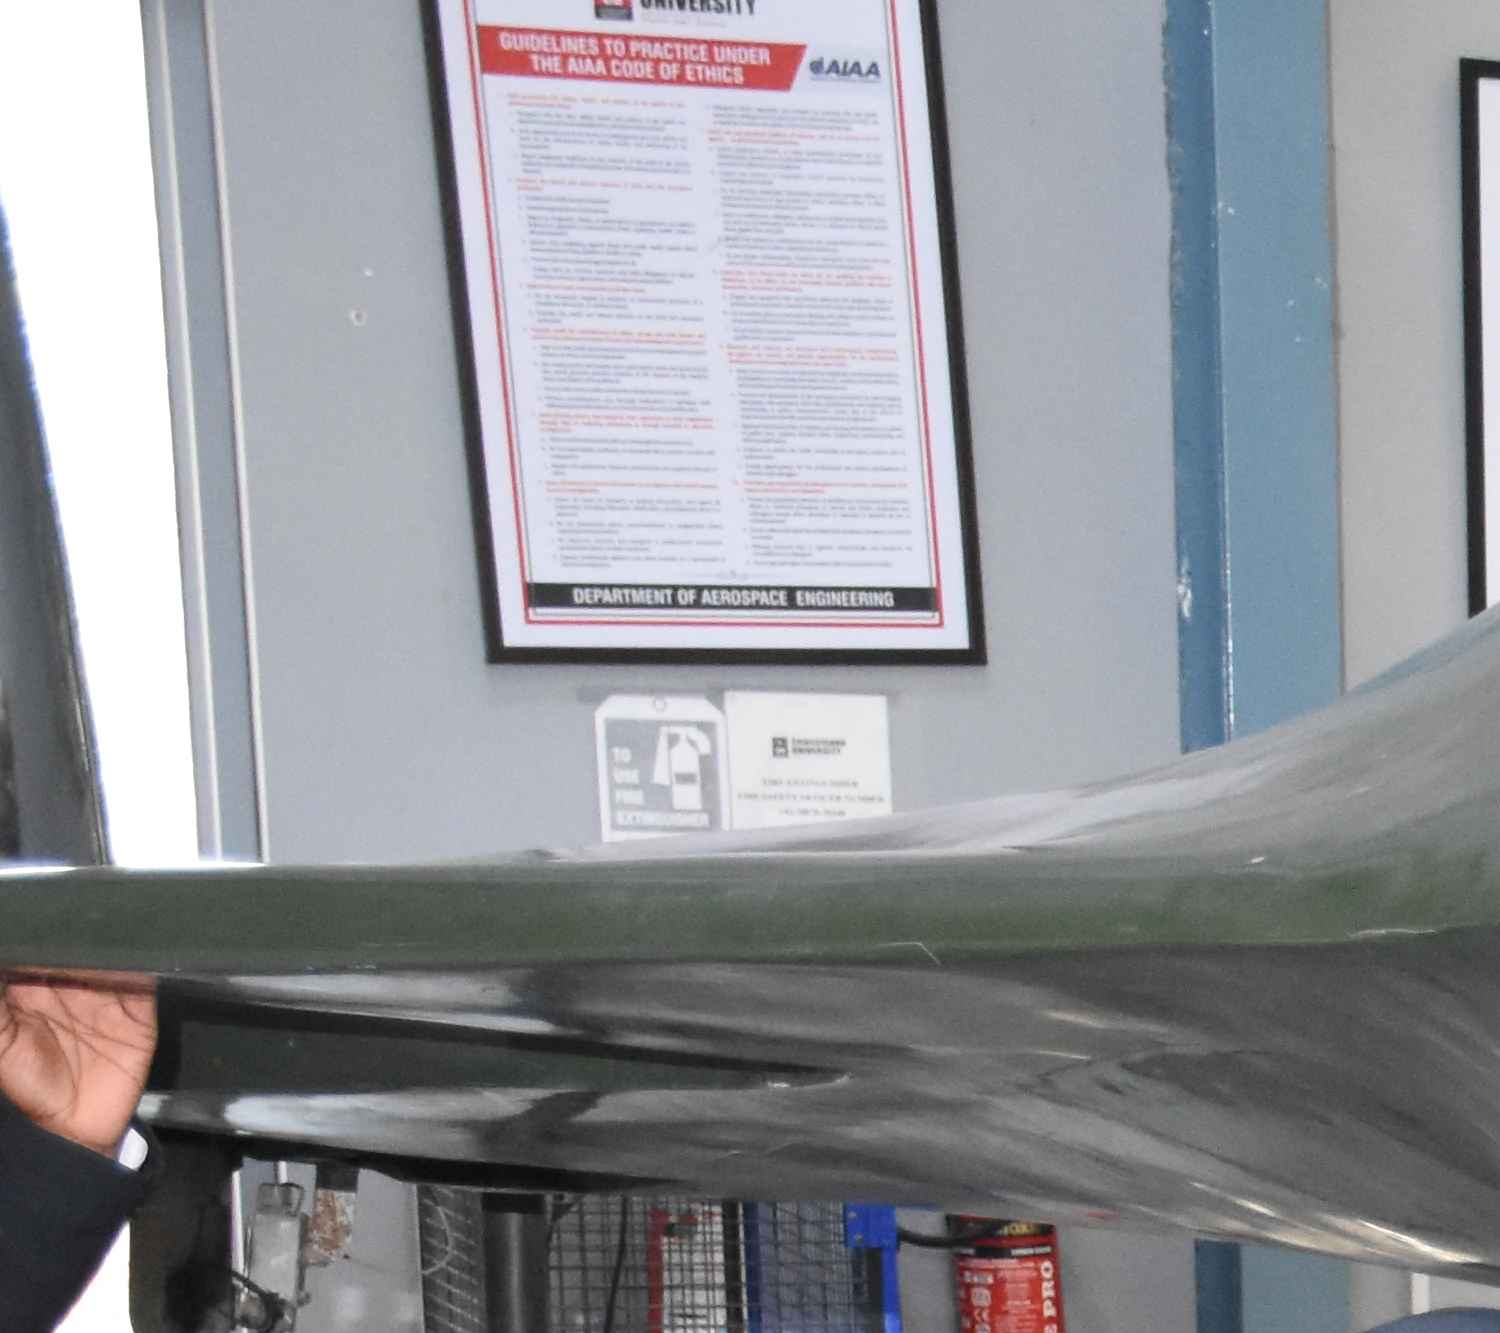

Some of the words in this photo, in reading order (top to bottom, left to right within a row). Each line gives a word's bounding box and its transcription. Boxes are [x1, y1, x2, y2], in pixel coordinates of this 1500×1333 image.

[500, 31, 600, 56] GUIDELINES
[603, 37, 627, 57] TO
[630, 37, 709, 62] PRACTICE
[713, 44, 772, 65] UNDER
[529, 54, 566, 74] THE
[567, 55, 606, 77] AIAA
[611, 58, 655, 80] CODE
[659, 61, 681, 81] OF
[684, 63, 745, 86] ETHICS
[826, 58, 882, 80] AIAA
[572, 585, 674, 606] DEPARTMENT
[676, 587, 698, 607] OF
[701, 588, 788, 608] AEROSPACE
[795, 589, 896, 609] ENGINEERING
[1040, 1259, 1057, 1319] PRO
